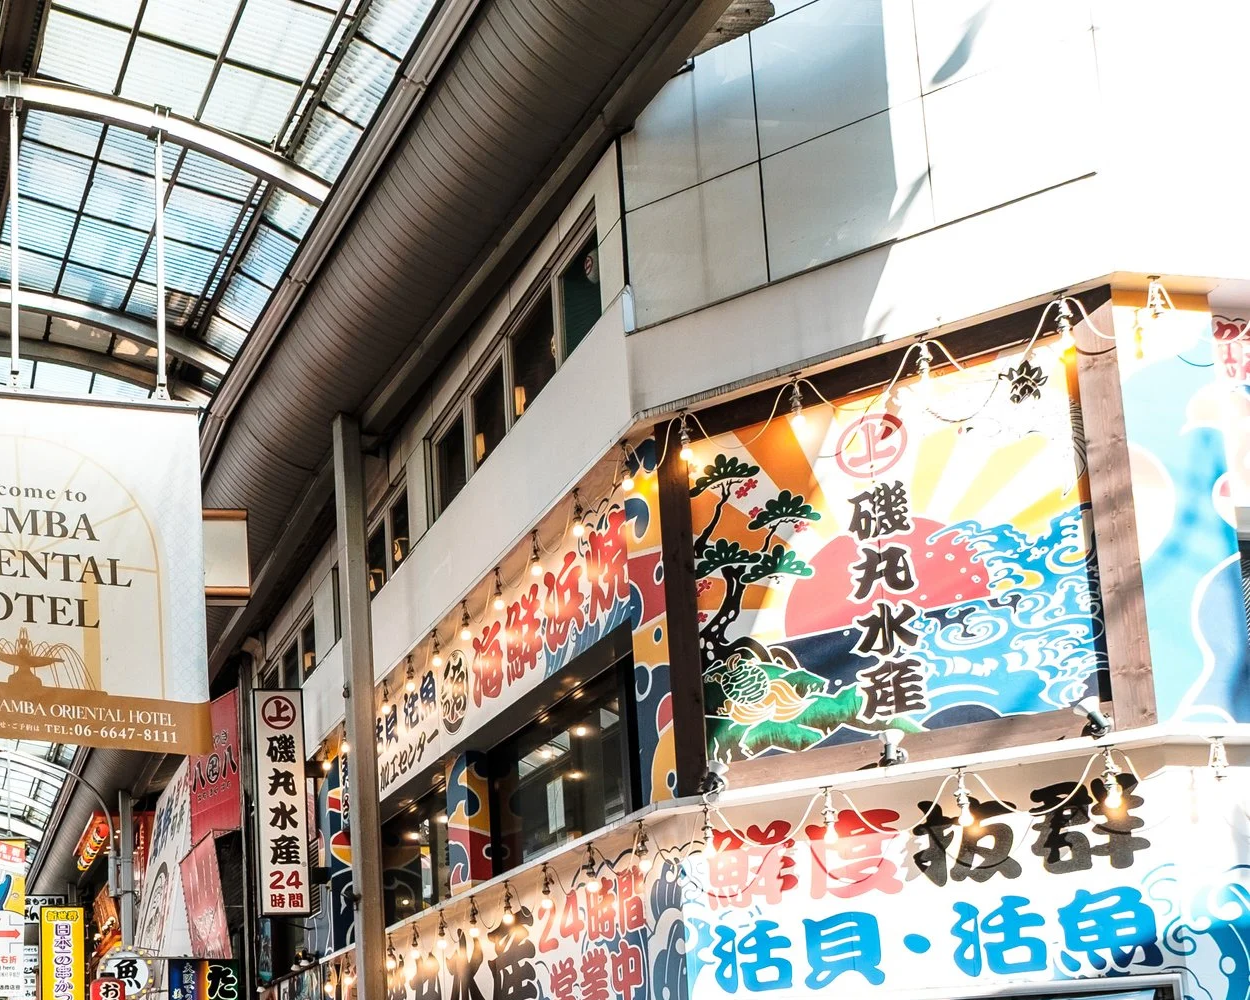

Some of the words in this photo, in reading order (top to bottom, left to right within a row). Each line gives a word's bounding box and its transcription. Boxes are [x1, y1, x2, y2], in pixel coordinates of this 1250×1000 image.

[65, 485, 88, 504] to
[472, 508, 632, 709] 海鮮浜焼
[848, 479, 927, 721] 磯丸水産
[50, 704, 126, 723] ORIENTAL
[129, 710, 176, 727] HOTEL
[266, 734, 301, 866] 磯丸水産
[707, 772, 1152, 911] 鮮度抜群
[269, 870, 303, 890] 24
[270, 894, 304, 909] 時間
[536, 864, 648, 955] 24時間
[712, 885, 1164, 995] 活貝・活魚
